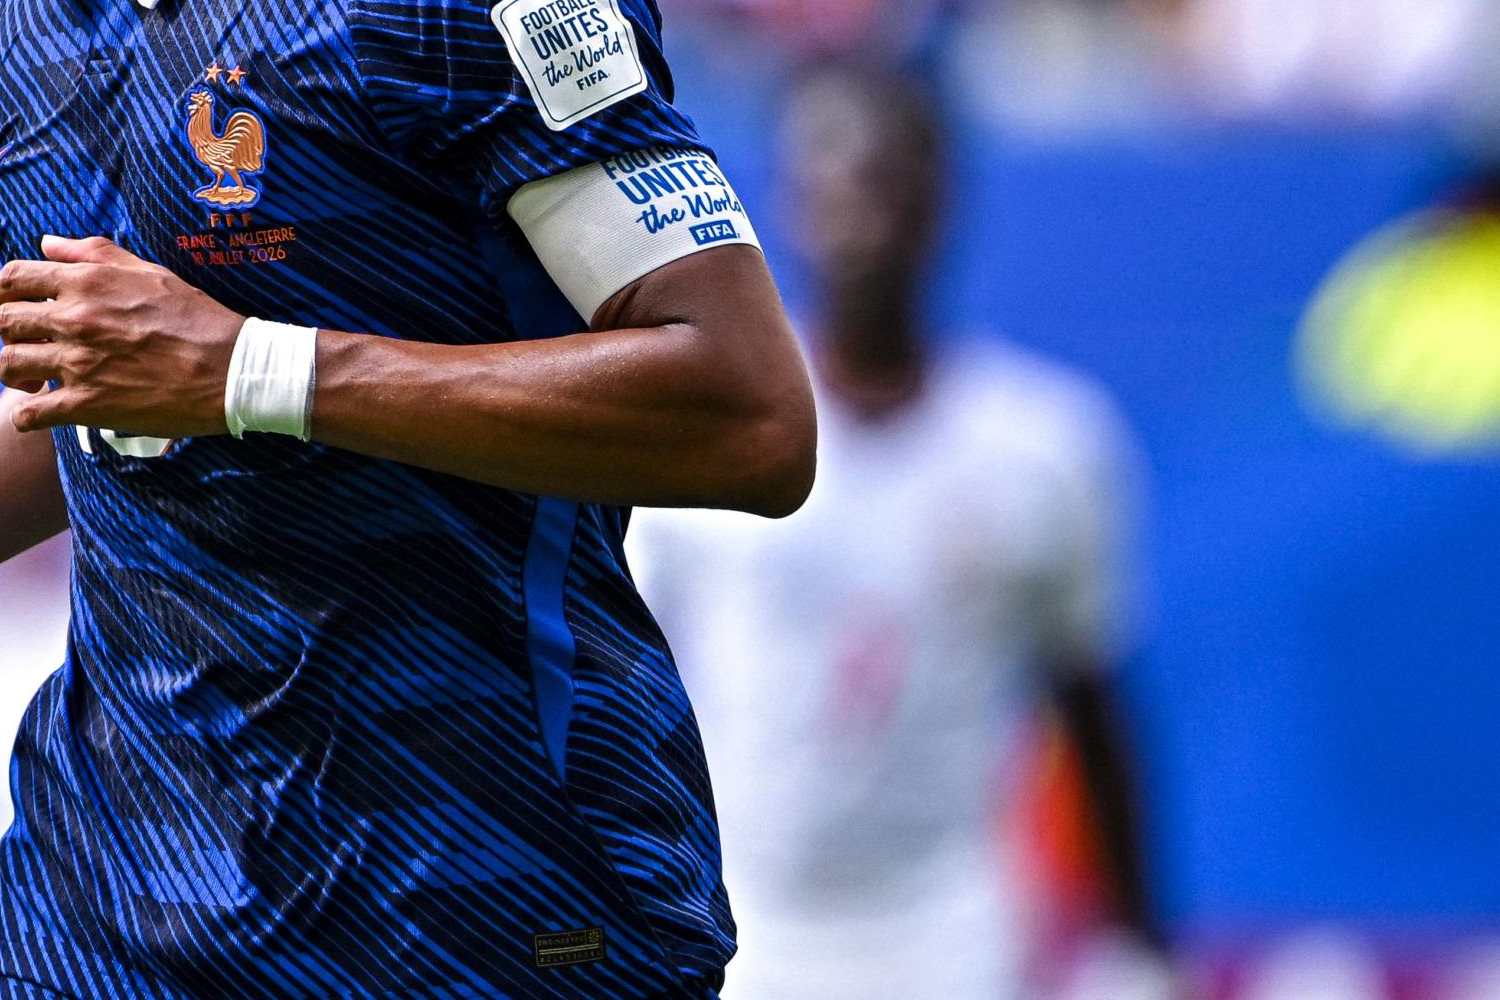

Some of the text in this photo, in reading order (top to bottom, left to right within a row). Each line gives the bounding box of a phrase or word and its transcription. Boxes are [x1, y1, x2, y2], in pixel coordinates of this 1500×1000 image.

[531, 8, 609, 60] UNITES
[541, 32, 624, 88] the World
[576, 70, 607, 91] FIFA
[616, 159, 726, 204] UNITES
[636, 204, 685, 234] the
[177, 234, 216, 248] FRANCE
[229, 227, 296, 247] ANGLETERRE
[694, 223, 734, 241] FIFA
[209, 250, 243, 265] JUILLET
[249, 245, 286, 263] 2026
